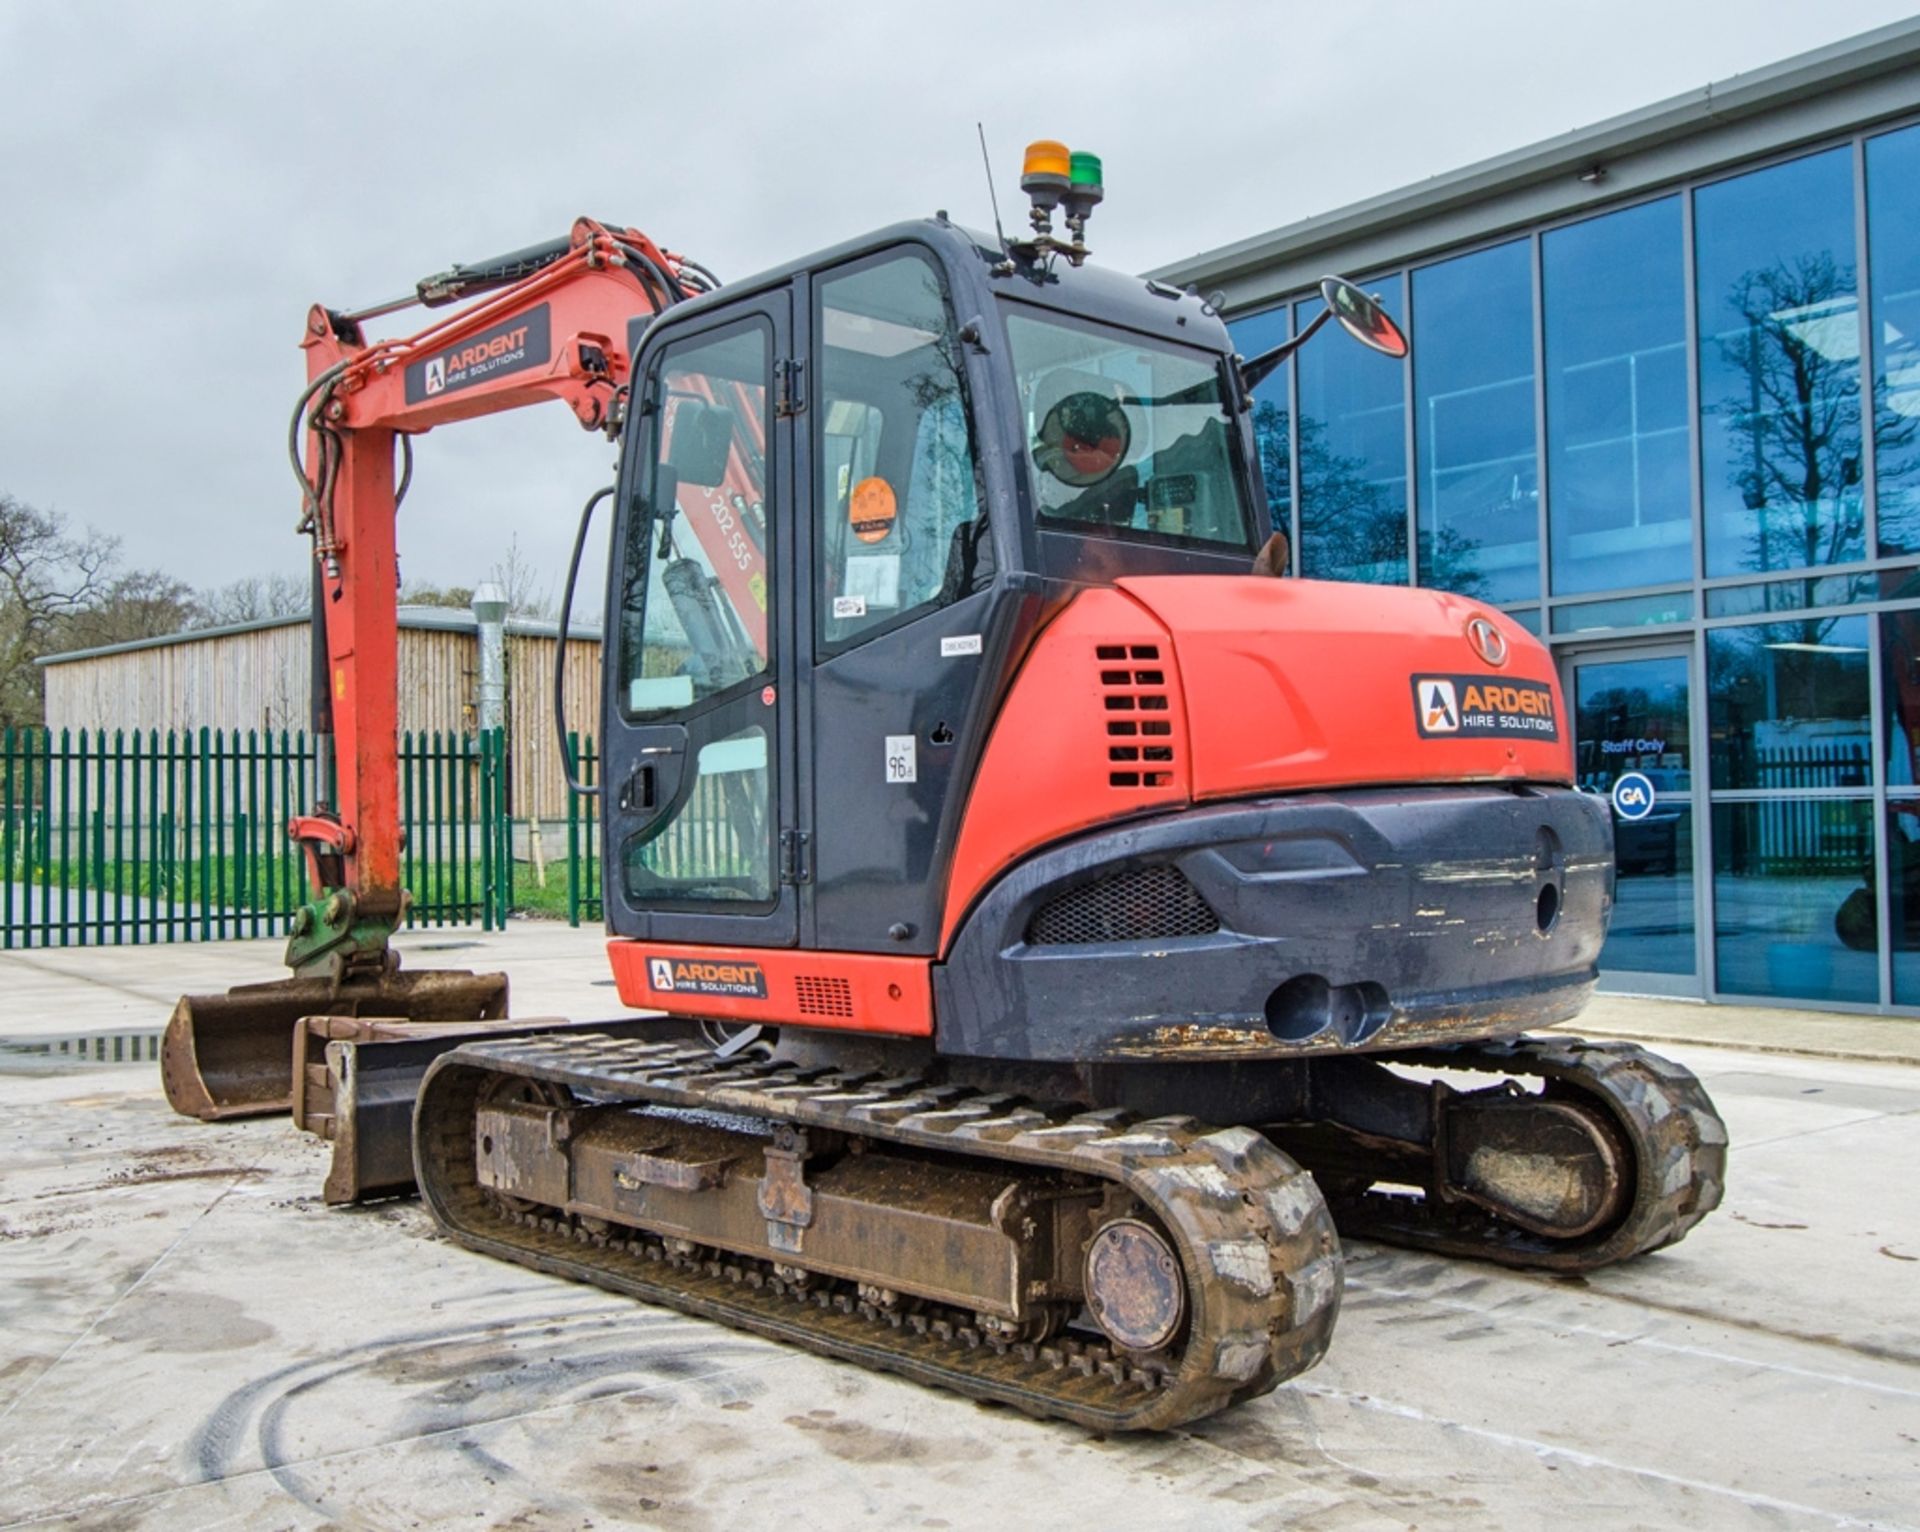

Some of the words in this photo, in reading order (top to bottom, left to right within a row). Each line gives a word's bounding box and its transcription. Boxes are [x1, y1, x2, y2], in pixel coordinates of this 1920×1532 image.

[448, 326, 528, 374] ARDENT
[446, 370, 467, 385] HIRE
[470, 348, 525, 377] SOLUTIONS
[711, 495, 734, 535] 202
[728, 532, 752, 571] 555
[1462, 684, 1552, 717] ARDENT
[1462, 715, 1496, 727] HIRE
[1499, 715, 1555, 732] SOLUTIONS
[1601, 739, 1634, 753] Staff
[1636, 738, 1665, 753] Only
[1619, 787, 1647, 805] GA
[675, 963, 758, 983] ARDENT
[675, 981, 698, 990] HIRE
[700, 982, 758, 994] SOLUTIONS
